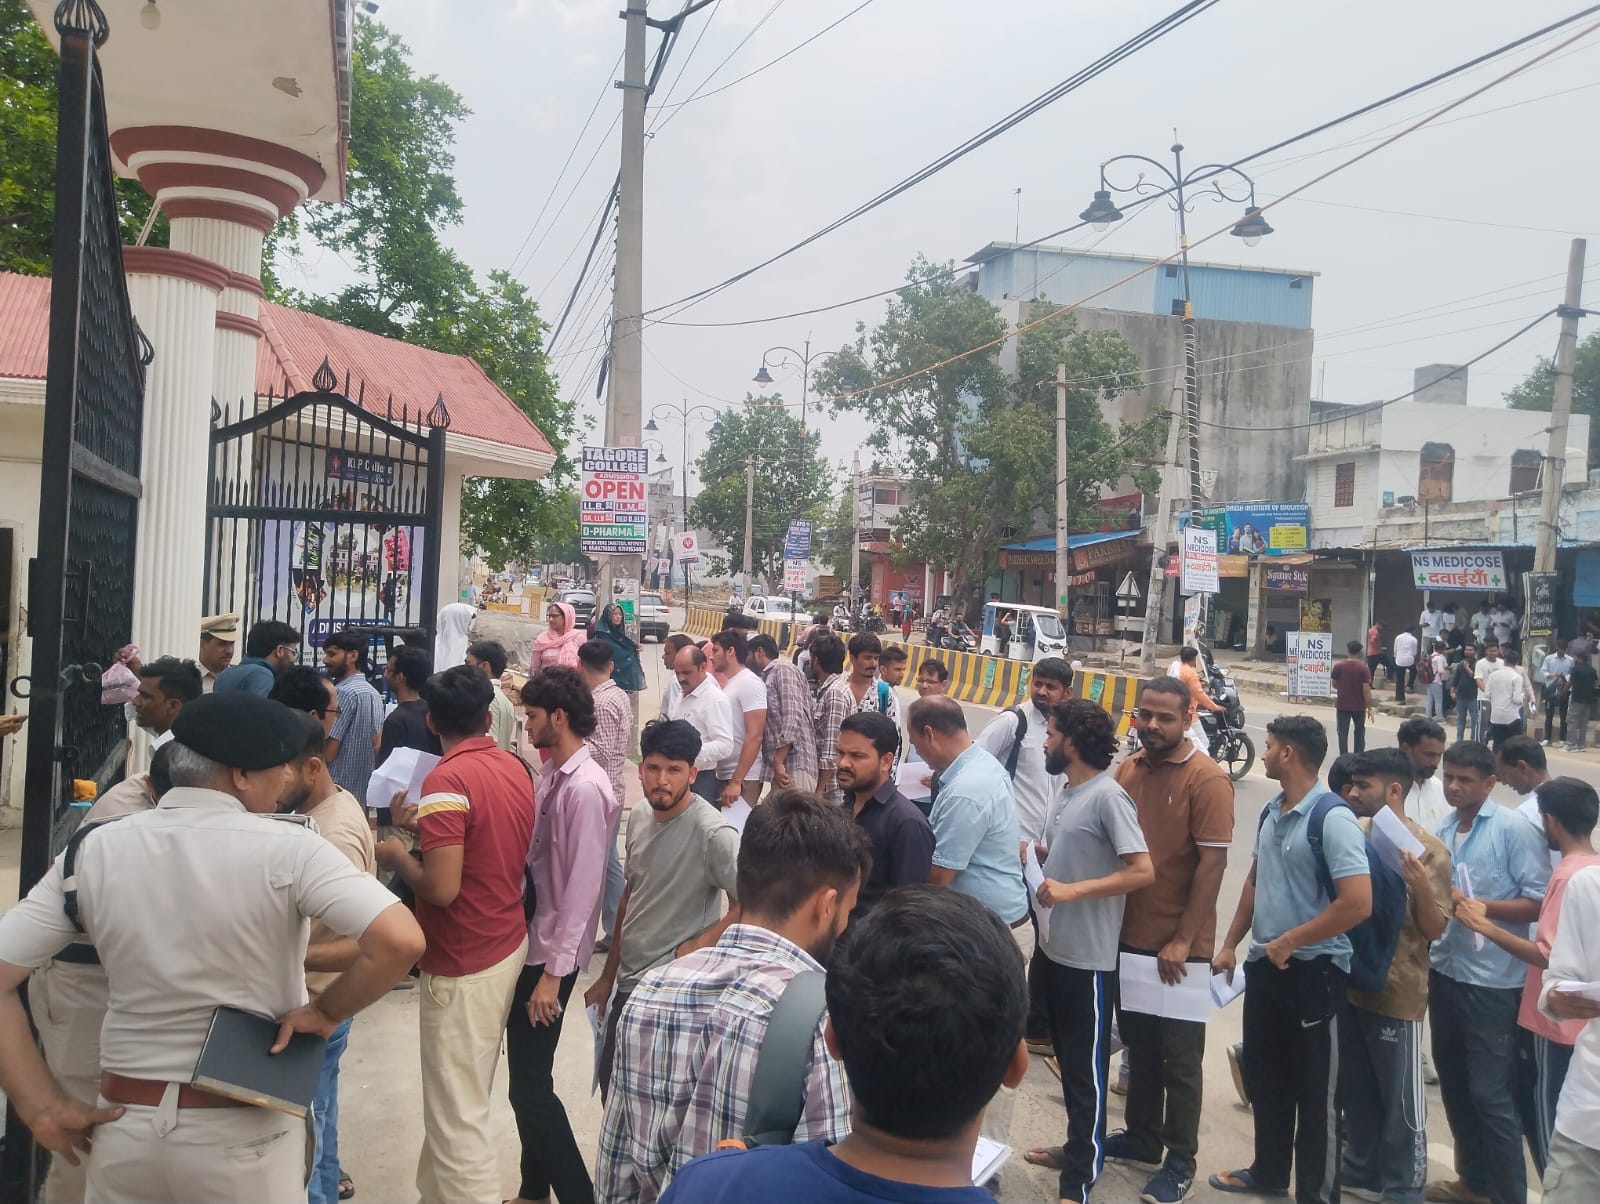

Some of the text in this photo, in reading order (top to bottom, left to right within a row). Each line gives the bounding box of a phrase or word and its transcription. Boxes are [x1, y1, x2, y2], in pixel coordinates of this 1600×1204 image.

[583, 447, 646, 462] TAGORE
[584, 460, 646, 473] COLLEGE
[585, 480, 645, 500] OPEN
[583, 526, 632, 537] D-PHARMA
[1193, 535, 1208, 545] NS
[1187, 544, 1216, 553] MEDICOSE
[1413, 556, 1502, 568] NS MEDICOSE
[1307, 639, 1323, 649] NS
[1300, 650, 1330, 660] MEDICOSE
